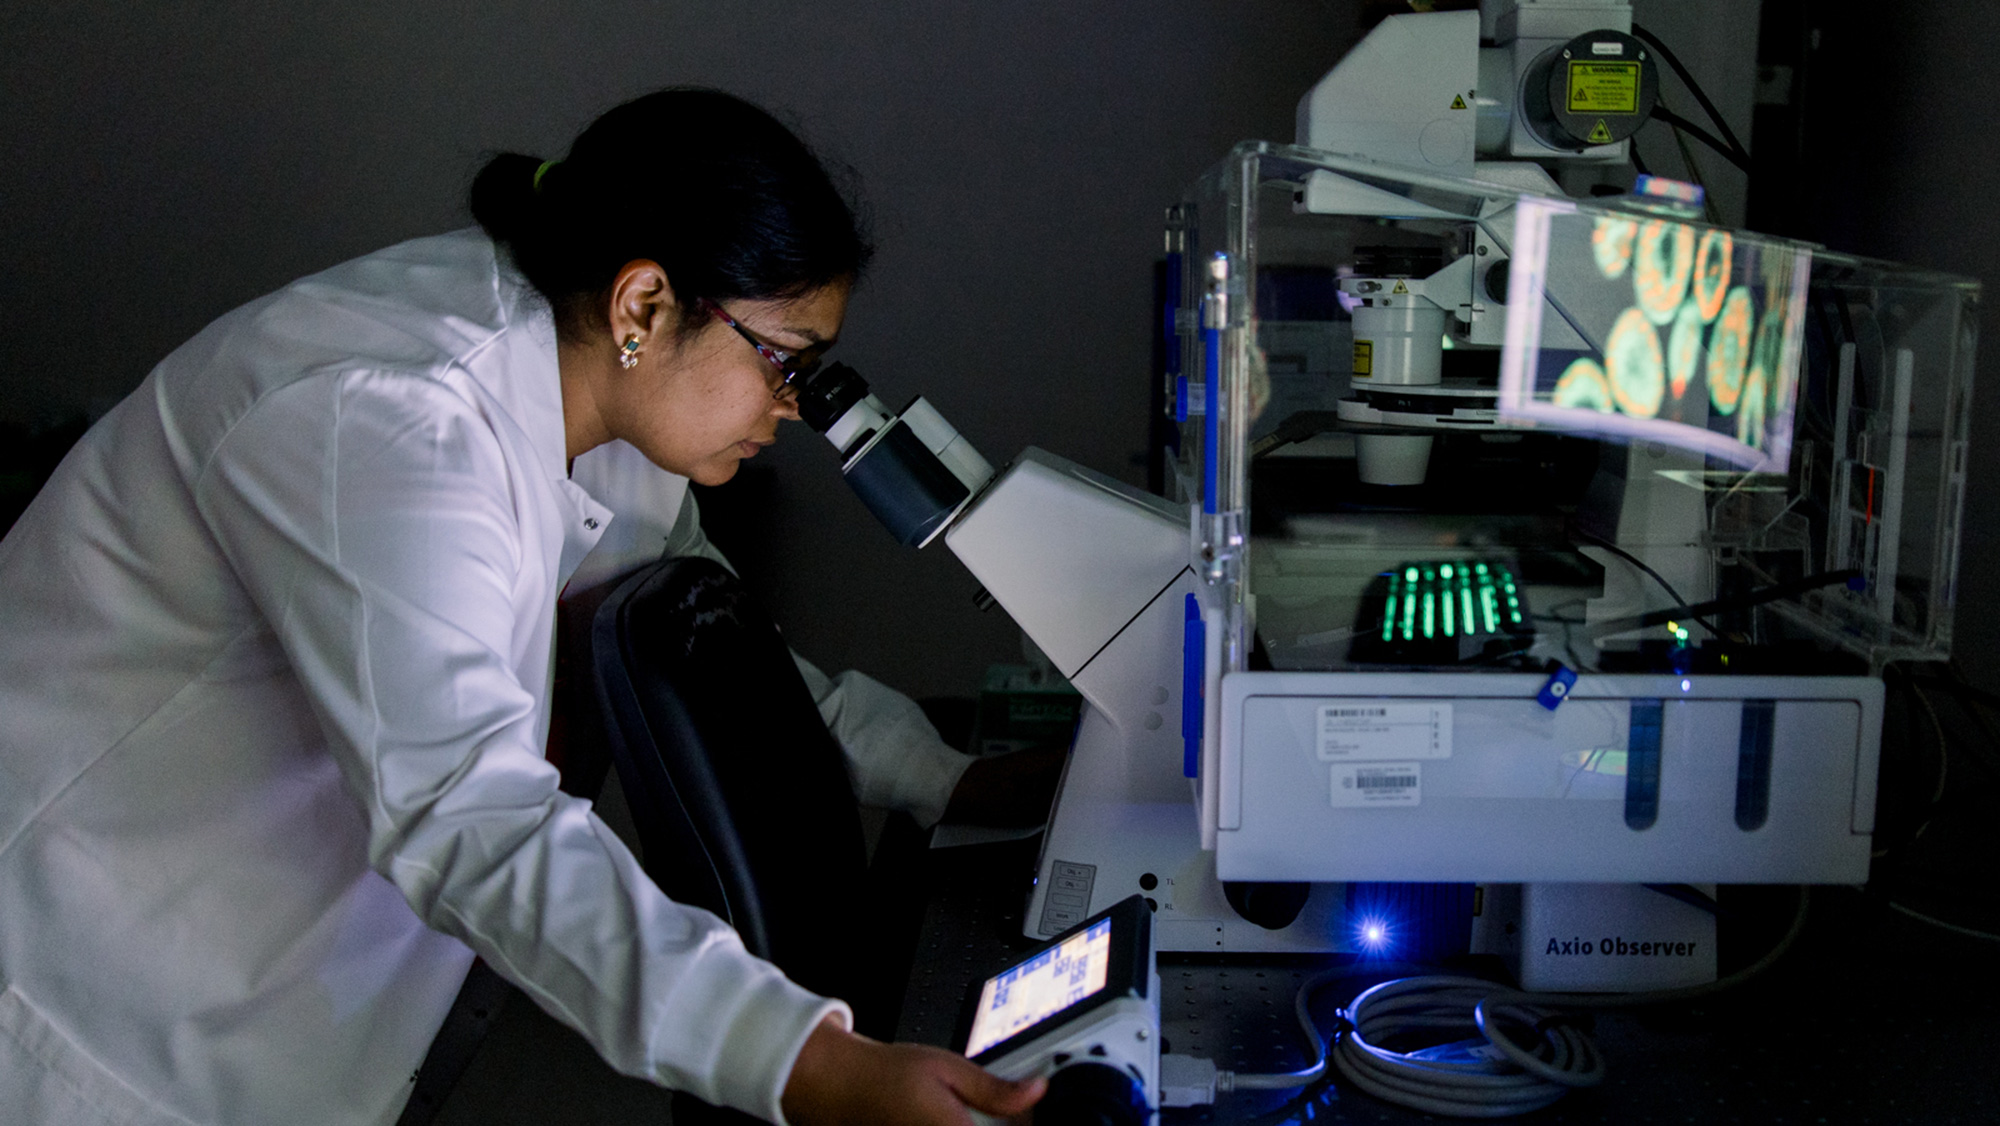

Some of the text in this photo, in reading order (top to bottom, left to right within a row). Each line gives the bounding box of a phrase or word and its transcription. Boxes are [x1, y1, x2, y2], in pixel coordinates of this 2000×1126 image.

[1166, 878, 1175, 886] TL
[1164, 903, 1174, 911] RL
[1546, 936, 1696, 957] Axio Observer
